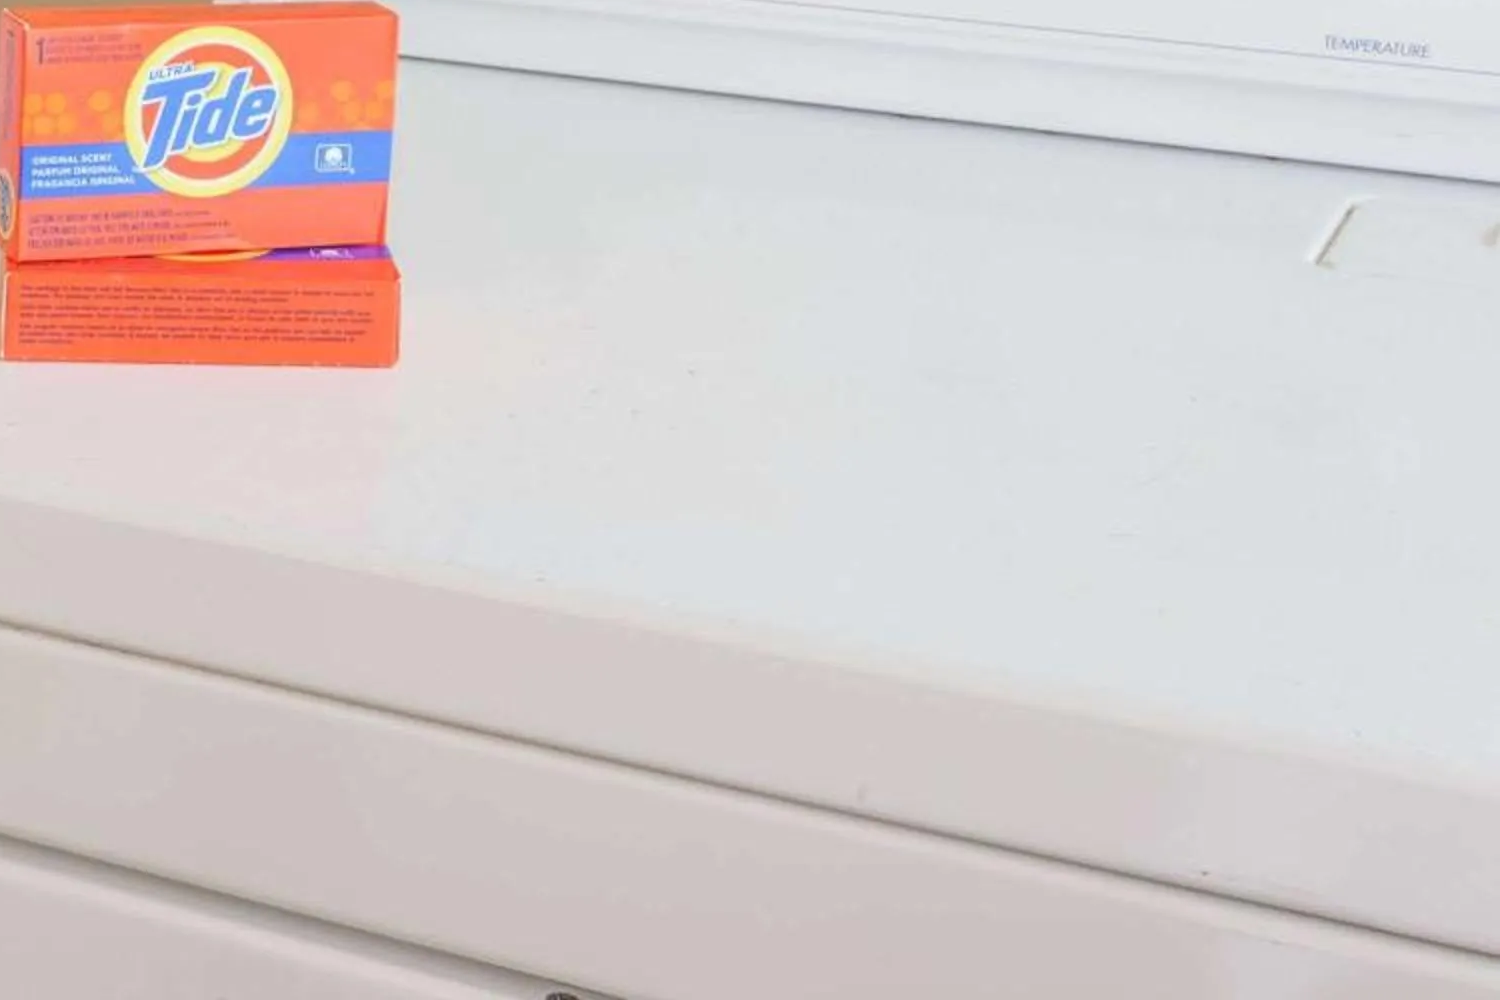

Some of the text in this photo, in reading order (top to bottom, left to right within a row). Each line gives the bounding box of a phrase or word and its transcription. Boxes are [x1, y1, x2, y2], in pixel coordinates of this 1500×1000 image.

[1325, 34, 1431, 59] TEMPERATURE
[149, 63, 195, 81] ULTRA
[140, 67, 279, 171] Tide
[32, 152, 112, 166] ORIGINAL SCENT
